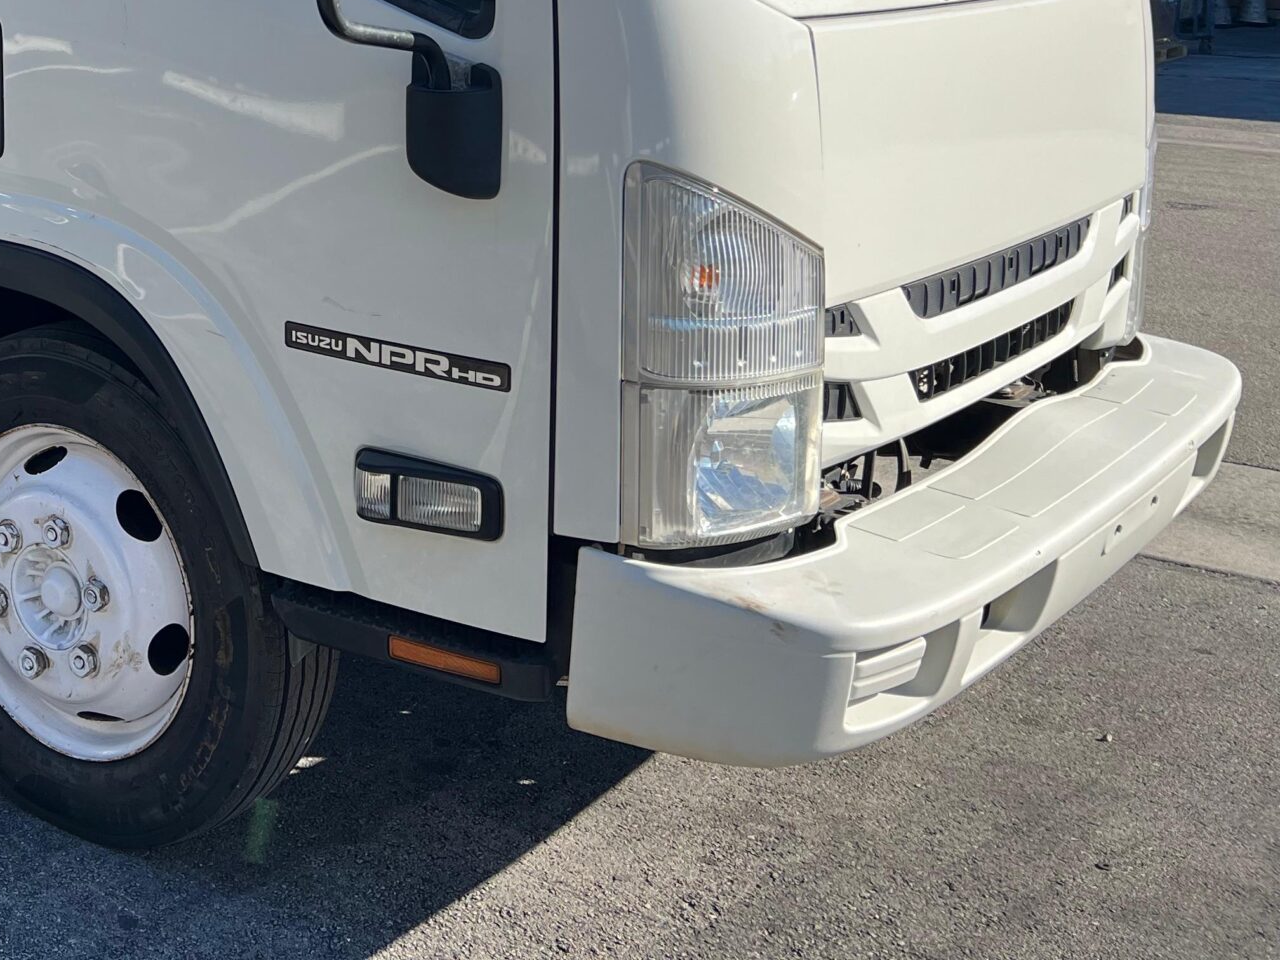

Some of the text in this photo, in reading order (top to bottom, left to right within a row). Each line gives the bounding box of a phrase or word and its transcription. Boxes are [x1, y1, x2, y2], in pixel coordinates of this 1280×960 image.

[291, 329, 502, 388] ISUZU NPR HD
